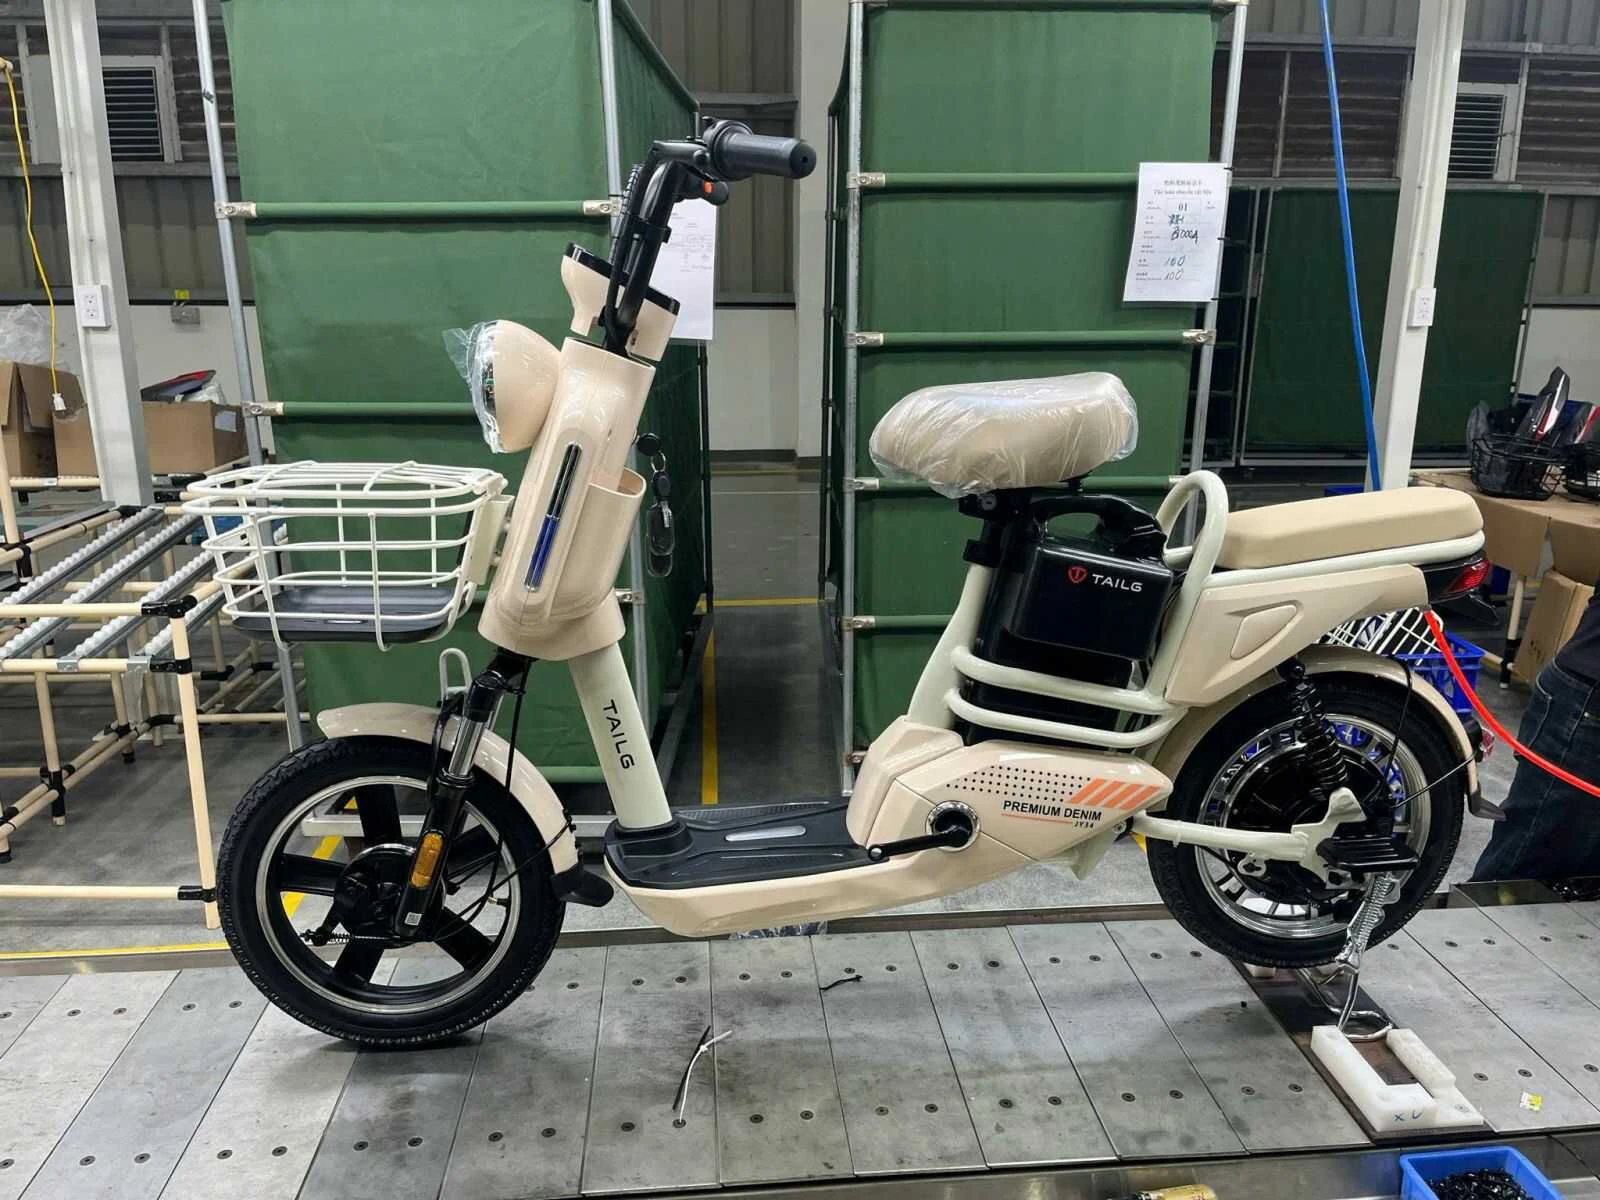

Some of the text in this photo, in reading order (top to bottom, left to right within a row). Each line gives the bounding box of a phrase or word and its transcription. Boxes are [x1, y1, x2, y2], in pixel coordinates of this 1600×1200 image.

[1091, 573, 1143, 593] TAILG
[603, 699, 636, 769] TAILG
[1003, 800, 1102, 821] PREMIUM DENIM
